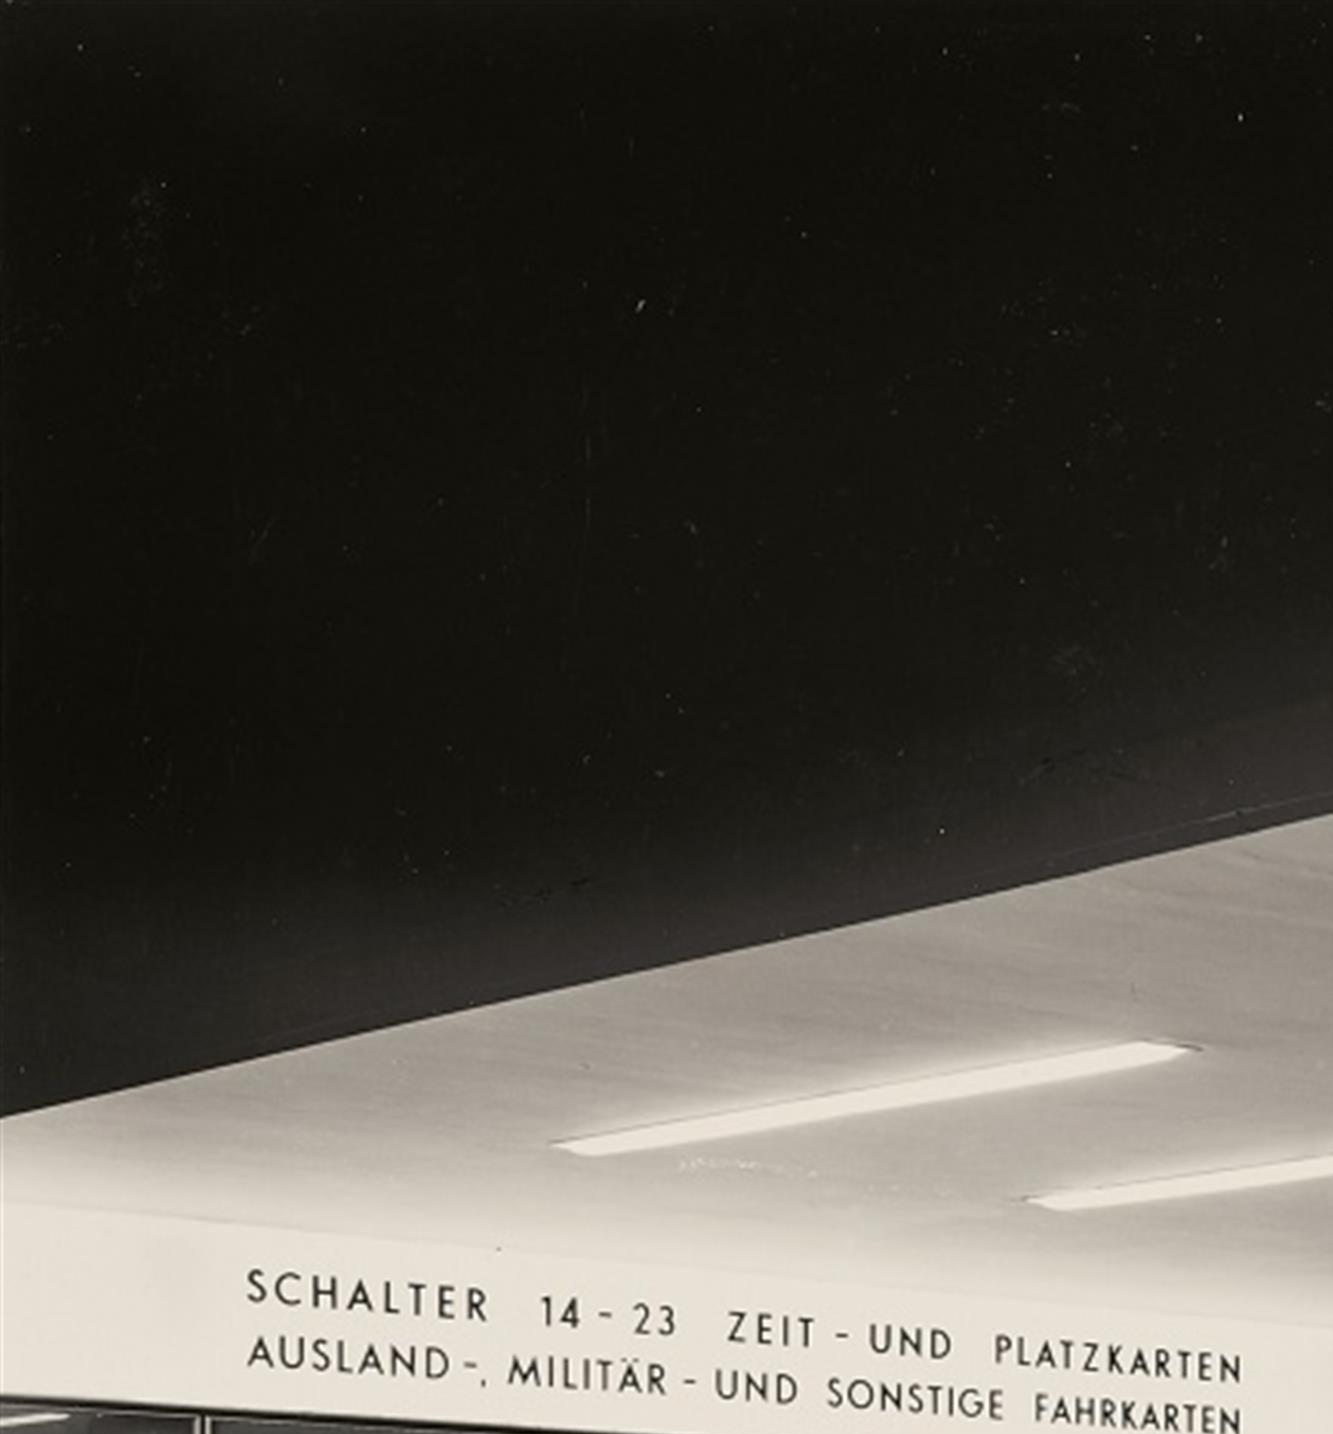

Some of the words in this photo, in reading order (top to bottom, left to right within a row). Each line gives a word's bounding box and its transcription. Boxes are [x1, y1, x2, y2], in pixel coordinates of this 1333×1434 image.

[247, 1268, 487, 1322] SCHALTER
[995, 1334, 1240, 1383] PLATZKARTEN
[827, 1377, 1003, 1420] SONSTIGE
